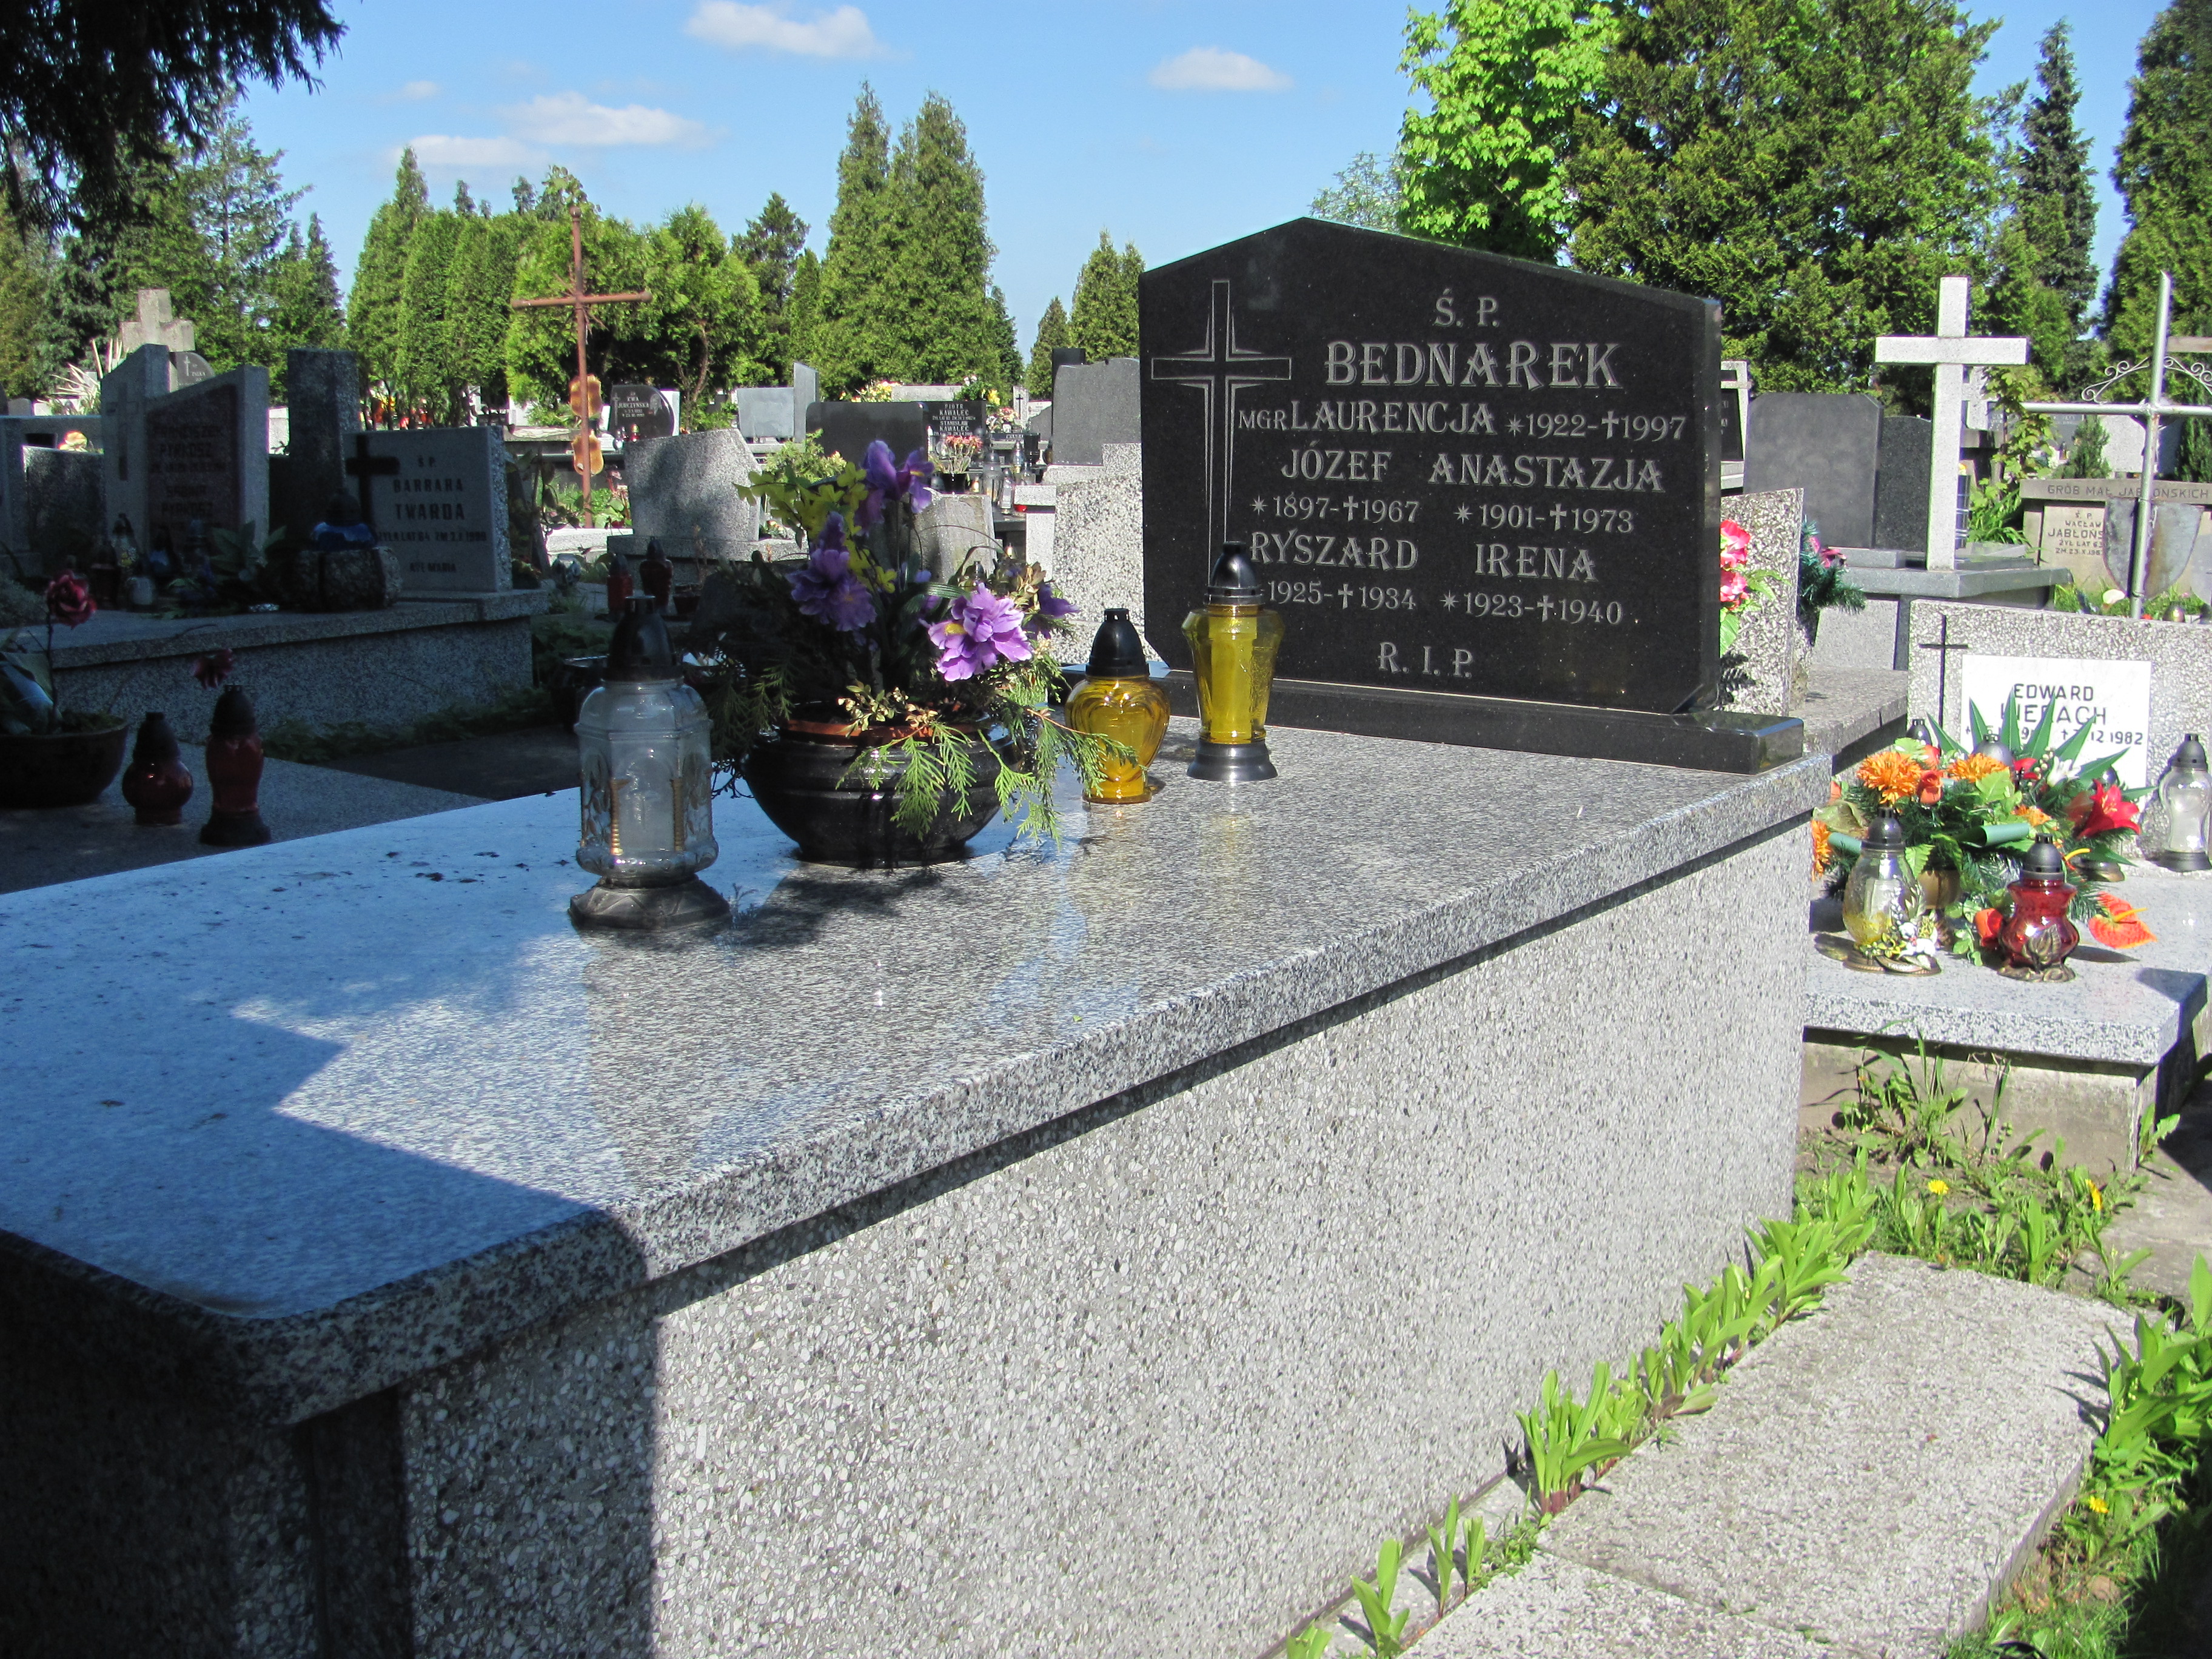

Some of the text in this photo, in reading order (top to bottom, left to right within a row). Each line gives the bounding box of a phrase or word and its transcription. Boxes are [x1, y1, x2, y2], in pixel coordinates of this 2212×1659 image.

[1476, 296, 1499, 327] P.
[1324, 340, 1623, 390] BEDNAREK
[1238, 409, 1289, 431] MGR
[1290, 399, 1497, 435] LAURENCJA
[1281, 439, 1666, 493] JÓZEF ANASTAZJA
[394, 478, 463, 492] BARBARA
[2048, 483, 2079, 495] GRÓB
[395, 503, 465, 520] TWARDA
[1250, 528, 1599, 582] RYSZARD IRENA
[2013, 683, 2094, 702] EDWARD
